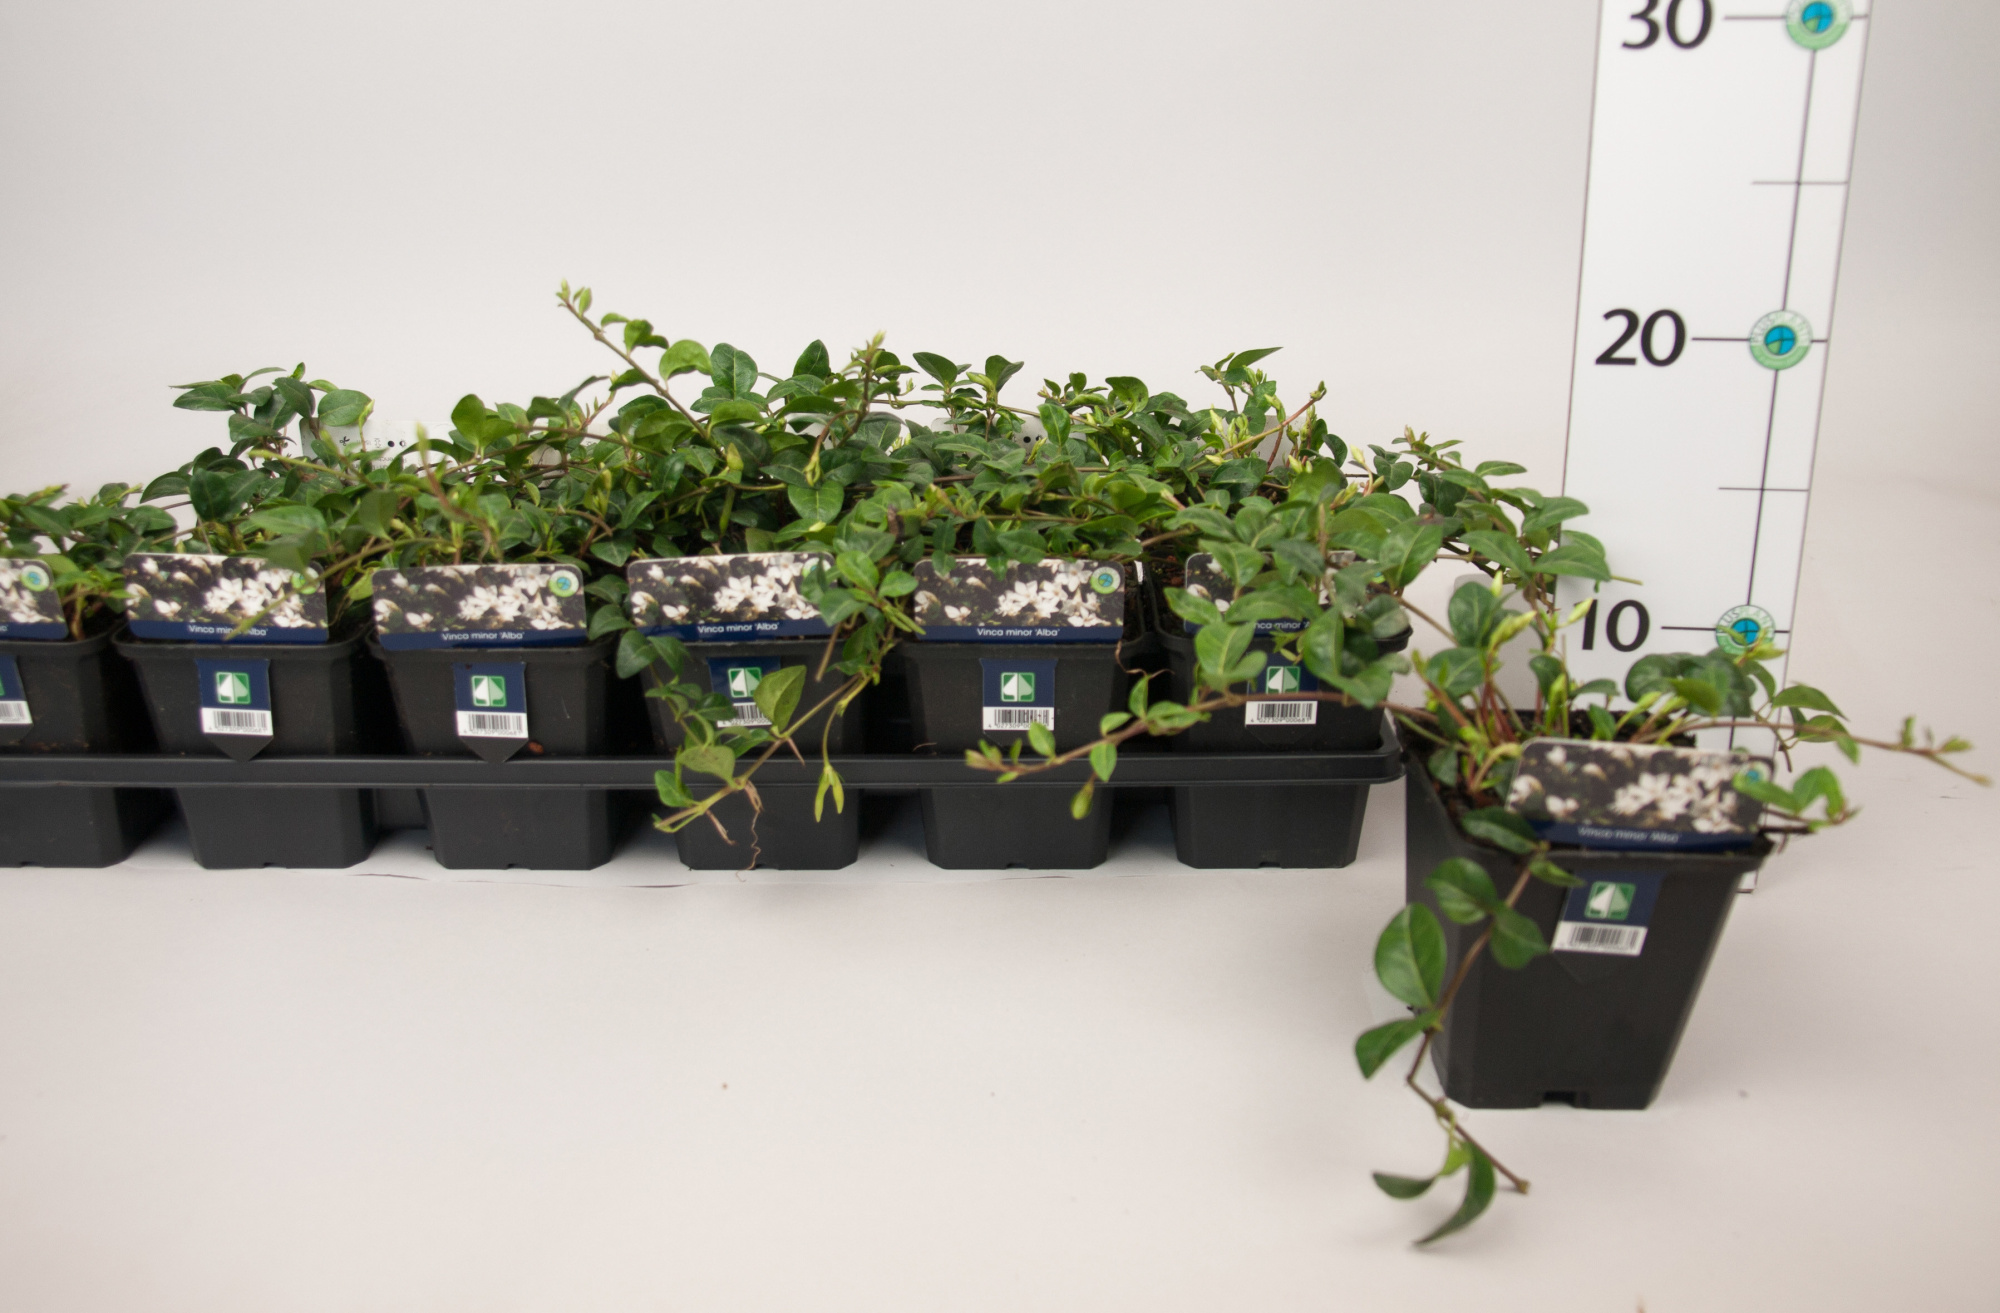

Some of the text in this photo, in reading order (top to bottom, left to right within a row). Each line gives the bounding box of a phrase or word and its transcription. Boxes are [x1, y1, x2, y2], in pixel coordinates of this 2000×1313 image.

[1621, 0, 1713, 50] 30
[1595, 308, 1686, 367] 20
[188, 625, 214, 634] Vinca
[216, 626, 241, 634] min
[697, 622, 779, 634] Vinca minor 'Alba'
[1573, 599, 1650, 652] 10
[500, 631, 525, 639] 'Alba'
[976, 628, 1060, 636] Vinca minor 'Alba'
